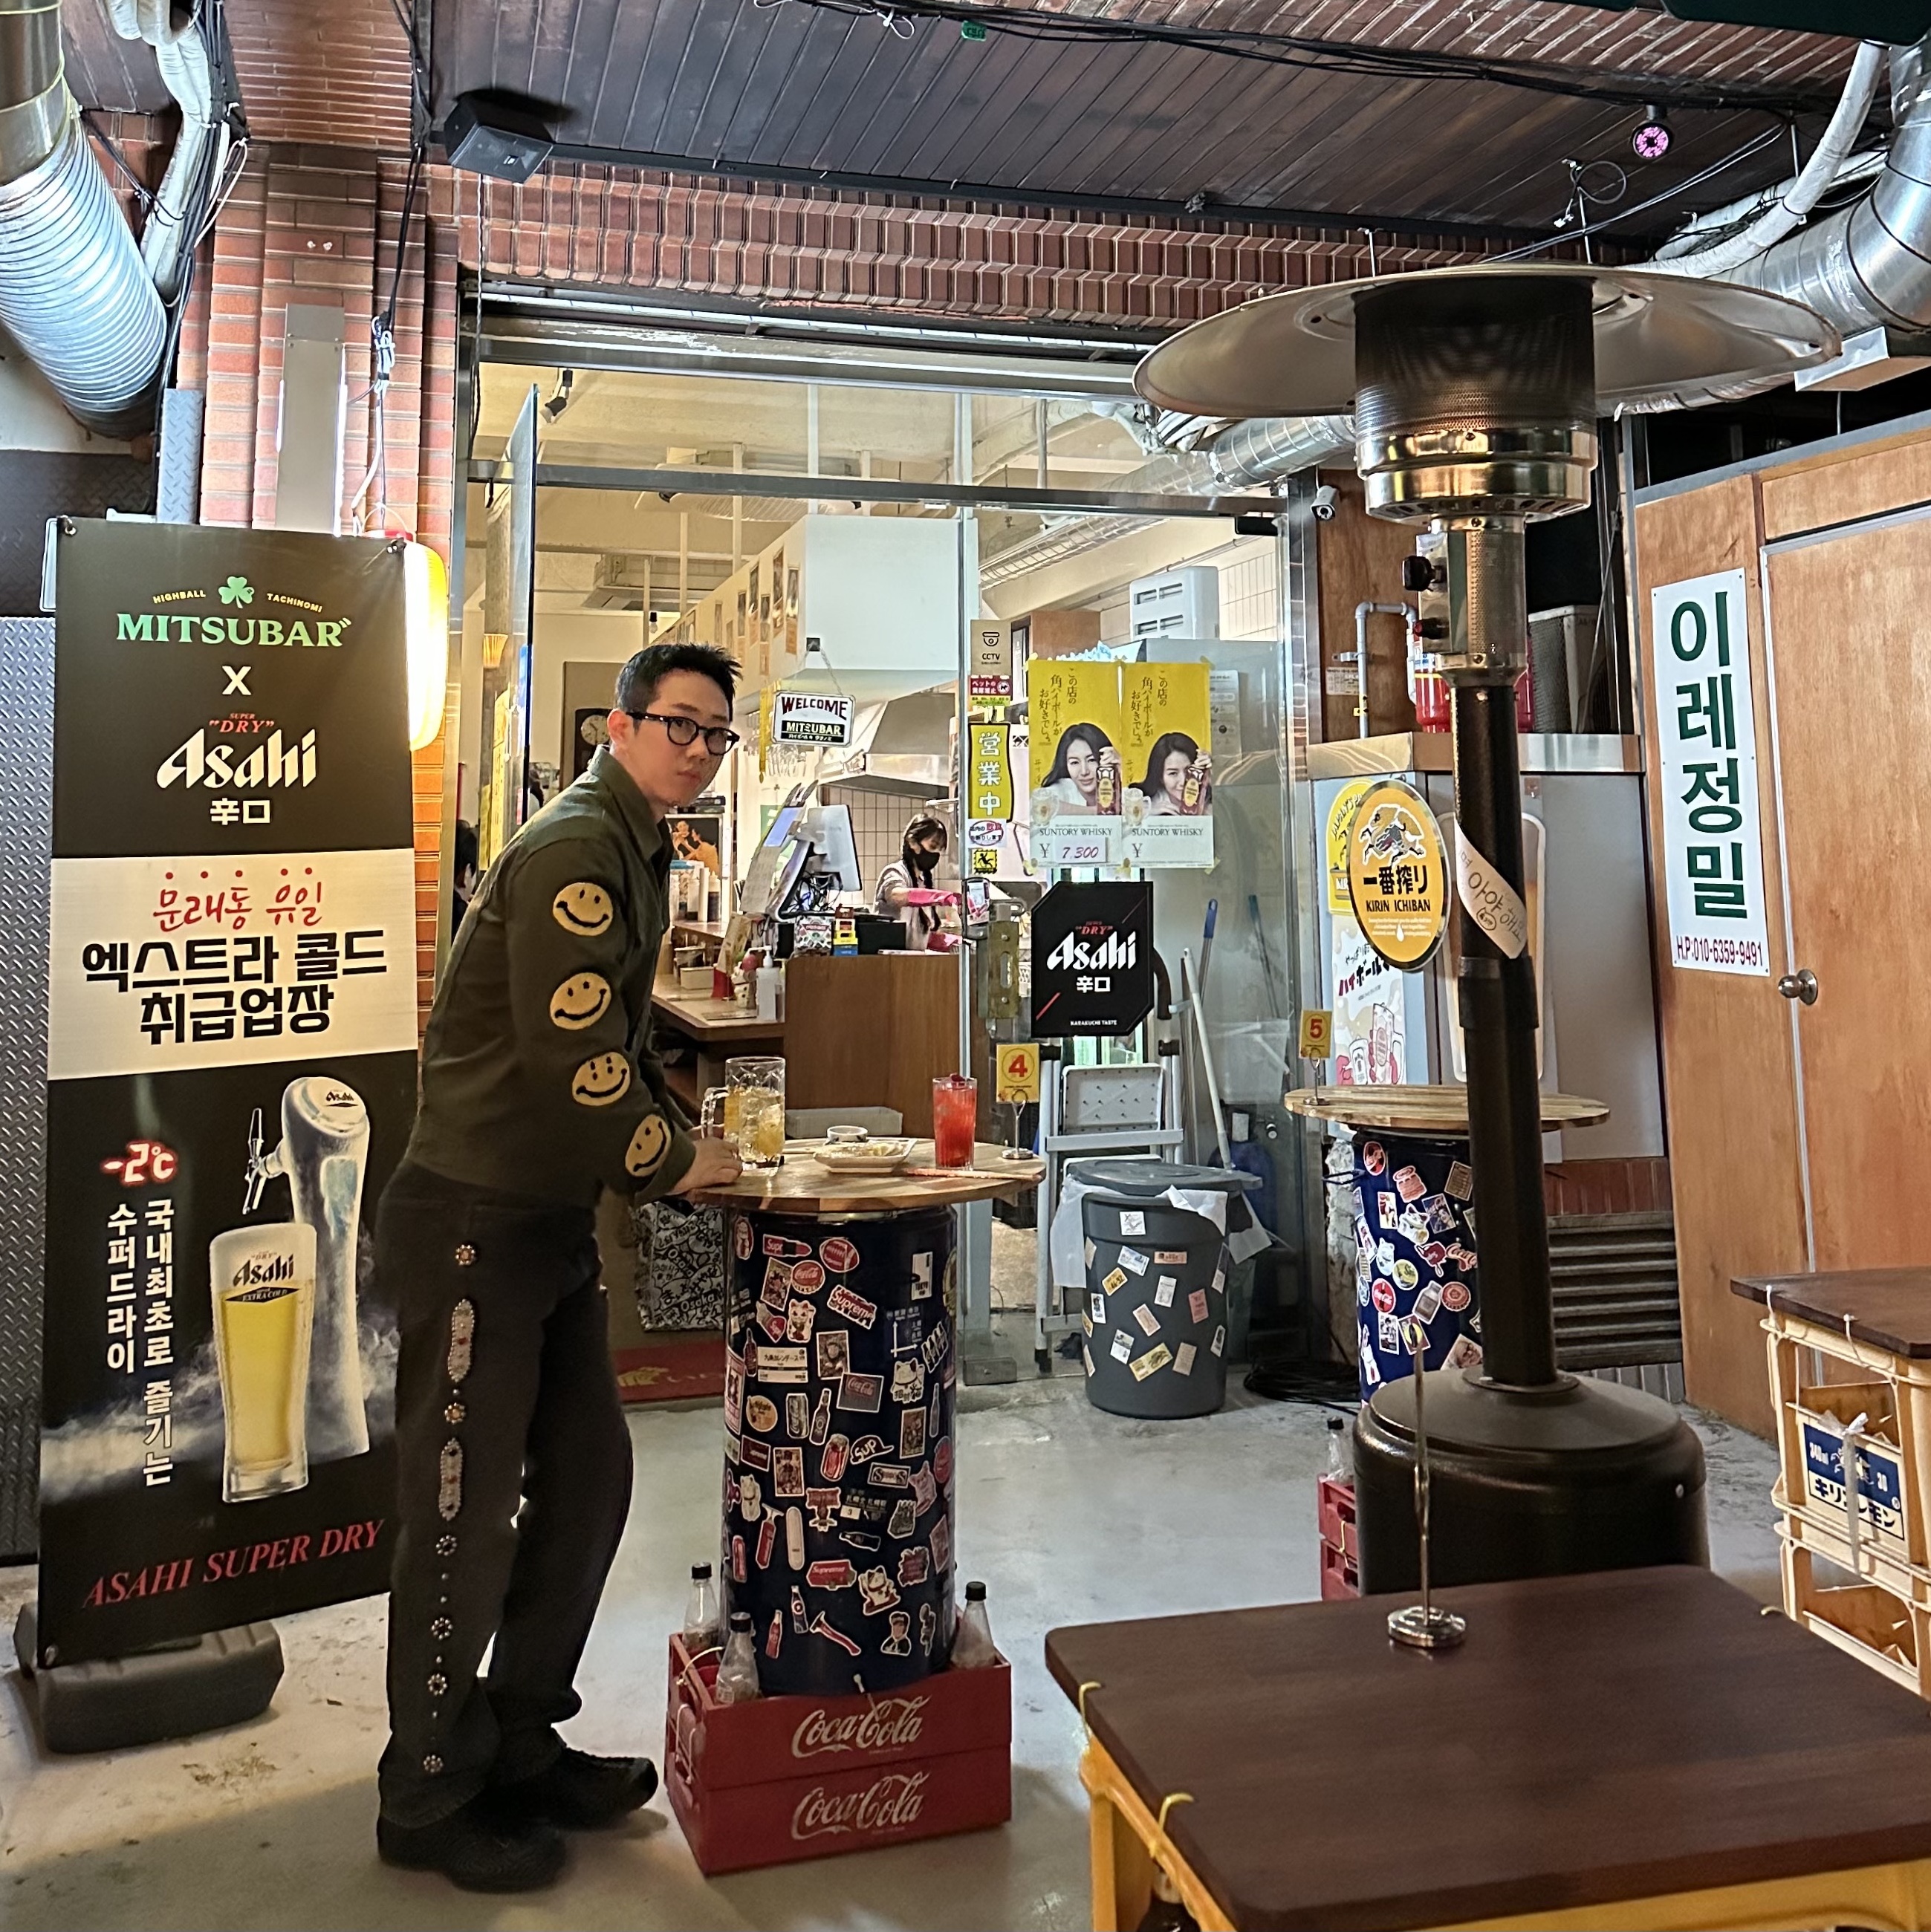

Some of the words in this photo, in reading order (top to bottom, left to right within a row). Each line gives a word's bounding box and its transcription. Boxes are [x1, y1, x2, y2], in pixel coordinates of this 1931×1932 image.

[152, 590, 206, 604] HIGHBALL
[267, 593, 322, 613] TACHINOMI
[1068, 667, 1077, 705] この店の
[1158, 670, 1168, 706] この店の
[782, 697, 848, 721] WELCOME
[1051, 674, 1062, 736] 角ハイボールが
[1142, 677, 1153, 737] 角ハイボールが
[786, 722, 841, 735] MITSUBAR
[157, 728, 316, 788] Asahi
[977, 731, 1002, 816] 営業中
[1670, 591, 1747, 920] 이레정밀
[210, 798, 270, 825] 辛口
[1039, 828, 1077, 836] SUNTORY
[1080, 828, 1112, 836] WHISKY
[1132, 828, 1169, 836] SUNTORY
[1172, 828, 1203, 836] WHISKY
[1039, 843, 1051, 859] ¥
[1132, 843, 1143, 858] ¥
[1363, 865, 1428, 895] 一番搾り
[152, 886, 253, 932] 문래동
[265, 881, 322, 926] 유일
[1366, 900, 1390, 912] KIRIN
[1394, 900, 1431, 912] ICHIBAN
[82, 935, 279, 993] 엑스트라
[294, 929, 387, 982] 콜드
[1047, 931, 1136, 970] Asahi
[1076, 975, 1111, 993] 辛口
[140, 983, 334, 1045] 취급업장
[1310, 1018, 1323, 1038] 5
[1008, 1055, 1028, 1077] 4
[325, 1091, 354, 1102] Asahi
[106, 1203, 137, 1373] 수퍼드라이
[143, 1199, 175, 1367] 국내최초로
[233, 1254, 294, 1287] Asahi
[242, 1291, 267, 1302] EXTRA
[680, 1293, 715, 1312] Osaka
[143, 1379, 173, 1486] 즐기는
[1814, 1477, 1895, 1528] キリモン
[82, 1558, 194, 1608] ASAHI
[203, 1535, 311, 1583] SUPER
[317, 1518, 385, 1558] DRY
[791, 1695, 932, 1758] Coca-Cola
[791, 1771, 931, 1840] Coca-Cola
